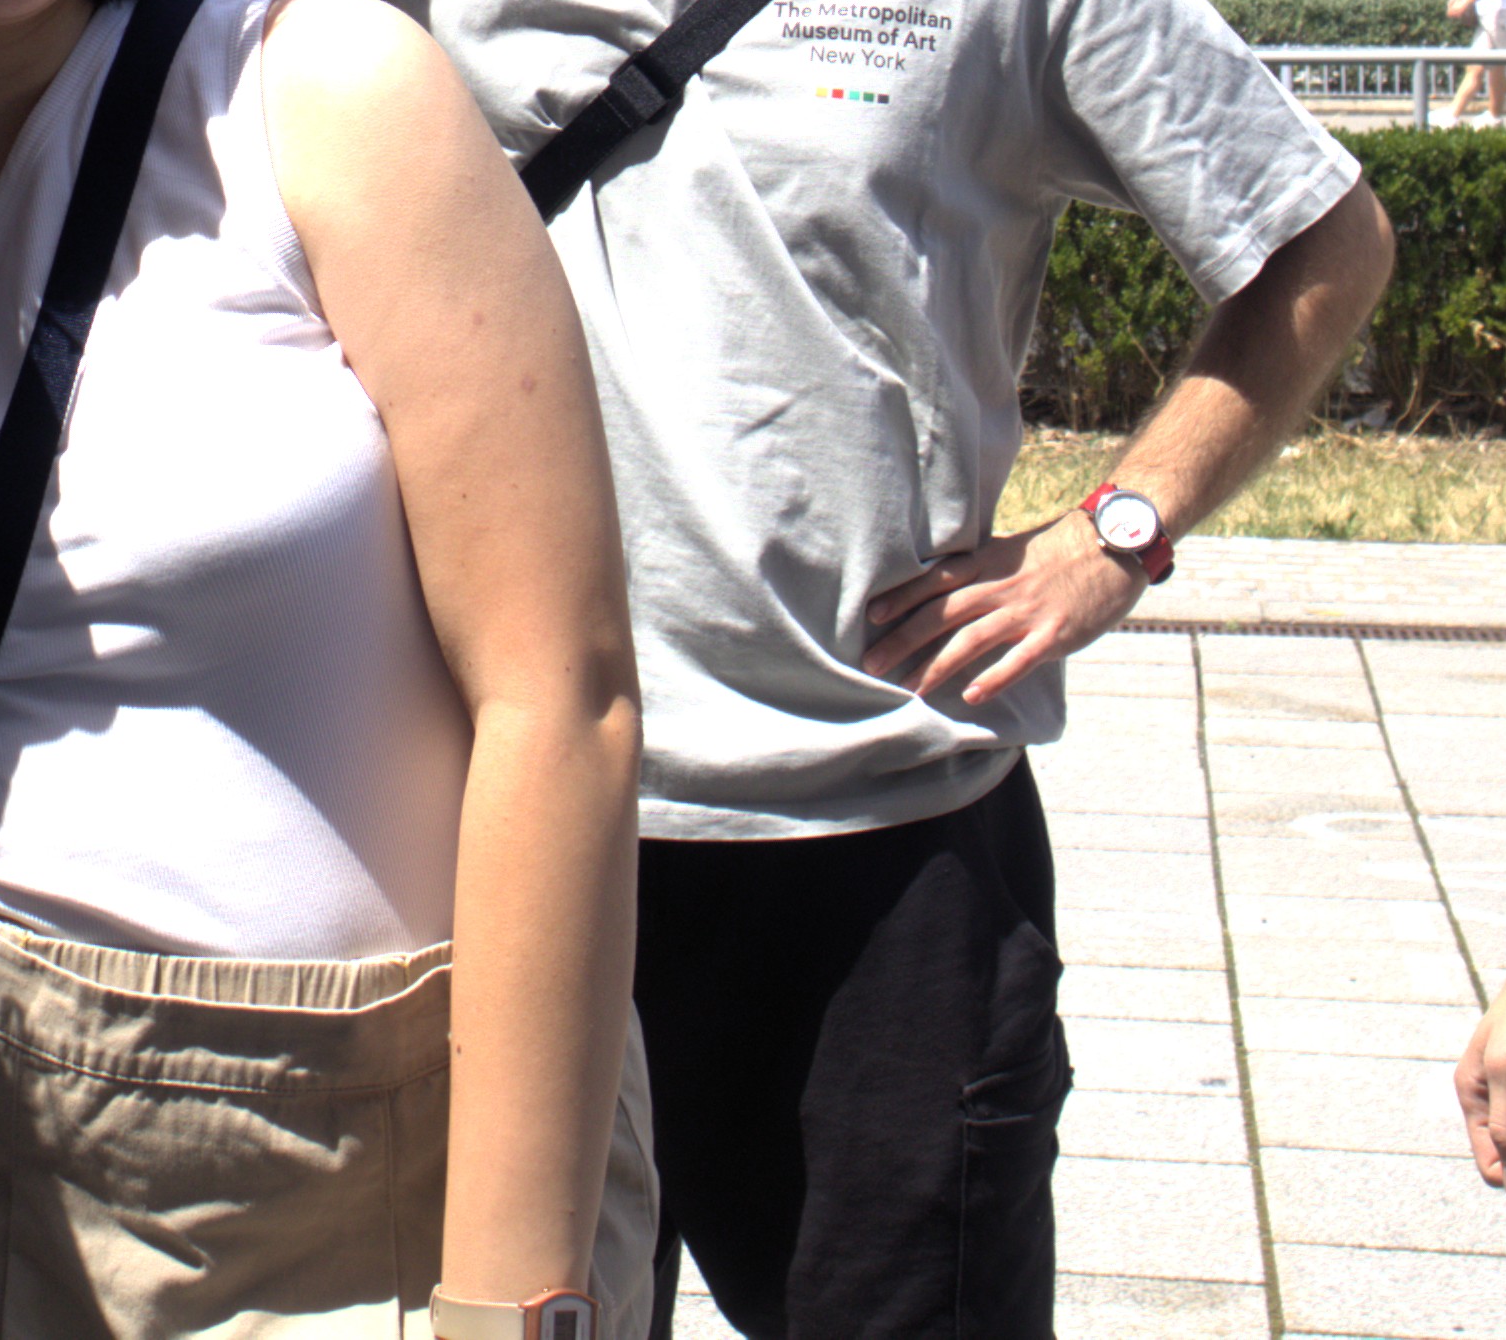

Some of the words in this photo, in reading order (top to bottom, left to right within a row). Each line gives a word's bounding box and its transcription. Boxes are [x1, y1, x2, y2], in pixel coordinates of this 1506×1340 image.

[773, 1, 812, 18] The
[818, 3, 953, 30] Metropolitan
[782, 21, 873, 43] Museum
[877, 27, 899, 46] of
[903, 31, 936, 52] Art
[809, 45, 855, 65] New
[861, 48, 907, 71] York
